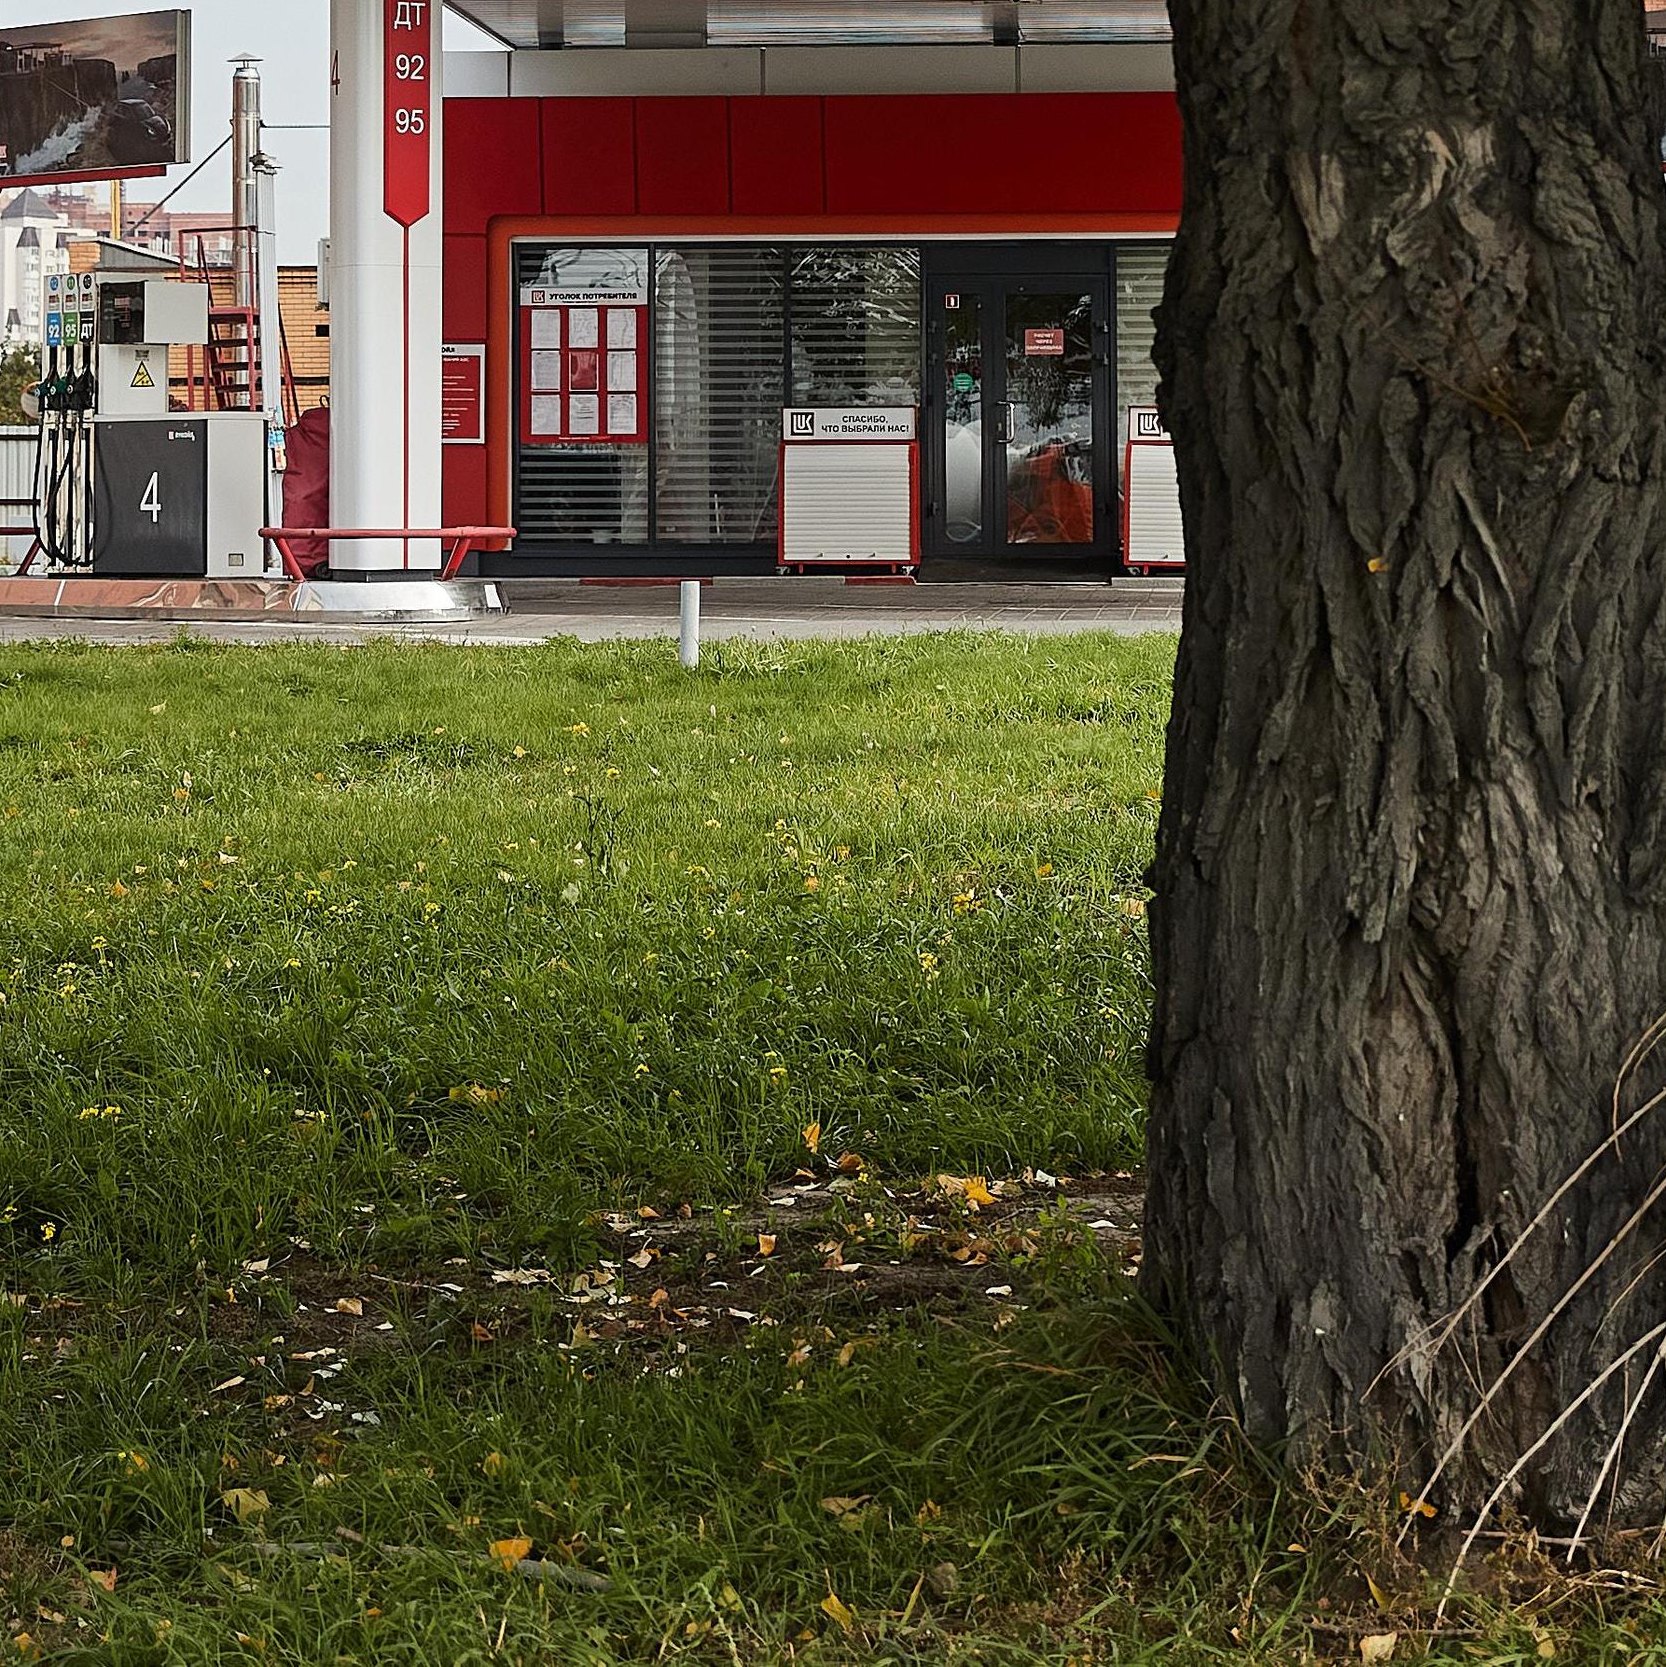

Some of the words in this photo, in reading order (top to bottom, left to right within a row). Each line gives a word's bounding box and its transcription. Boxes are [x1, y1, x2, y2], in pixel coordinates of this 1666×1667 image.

[394, 1, 426, 30] ДТ
[331, 49, 341, 96] 4
[395, 54, 425, 80] 92
[395, 108, 424, 134] 95
[48, 324, 60, 338] 92
[65, 324, 76, 338] 95
[81, 323, 93, 339] ДТ
[821, 425, 839, 433] ЧТО
[841, 425, 885, 433] ВЫБРАЛИ
[887, 425, 909, 433] НАС!
[842, 415, 888, 424] СПАСИБО,
[140, 471, 162, 523] 4
